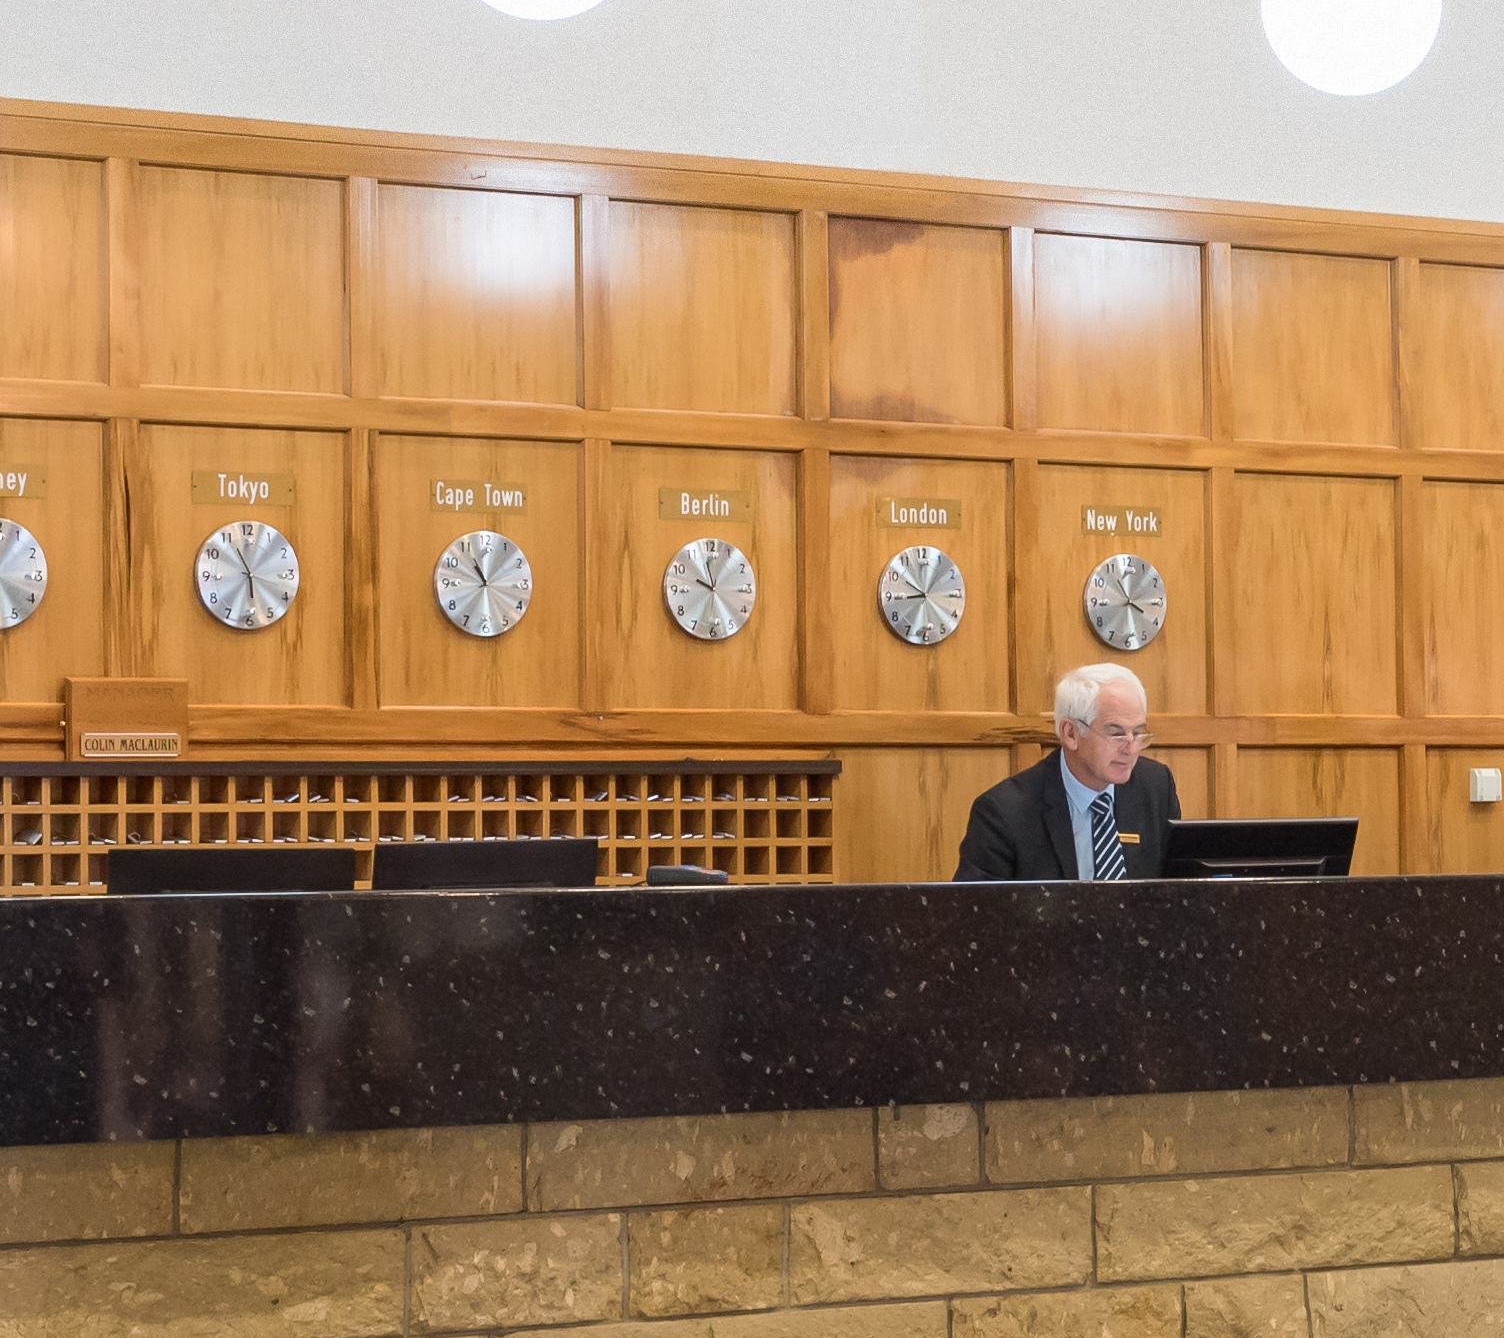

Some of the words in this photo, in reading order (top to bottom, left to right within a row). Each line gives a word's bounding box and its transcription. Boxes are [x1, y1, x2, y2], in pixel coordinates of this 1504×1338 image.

[218, 474, 269, 504] Tokyo
[436, 481, 474, 510] Cape
[484, 484, 523, 506] Town
[681, 493, 729, 516] Berlin
[891, 502, 947, 524] London
[1087, 509, 1117, 531] New
[1126, 511, 1157, 532] York
[242, 525, 253, 535] 12
[222, 533, 231, 543] 11
[480, 535, 491, 545] 12
[461, 542, 470, 552] 11
[706, 542, 715, 552] 12
[30, 548, 36, 559] 2
[207, 549, 219, 559] 10
[281, 548, 287, 559] 2
[687, 549, 696, 559] 11
[917, 549, 926, 558] 12
[447, 557, 458, 567] 10
[517, 558, 522, 569] 2
[901, 556, 909, 566] 11
[1123, 557, 1131, 566] 12
[674, 564, 685, 574] 10
[740, 564, 745, 573] 2
[1106, 564, 1115, 573] 11
[202, 571, 210, 581] 9
[888, 571, 898, 581] 10
[951, 569, 955, 579] 2
[442, 578, 449, 589] 9
[1094, 578, 1104, 588] 10
[1153, 578, 1157, 588] 2
[671, 585, 677, 595] 9
[27, 593, 35, 604] 4
[210, 593, 217, 603] 8
[282, 592, 288, 602] 4
[886, 592, 892, 602] 9
[449, 600, 456, 610] 8
[516, 601, 523, 610] 4
[1091, 598, 1097, 607] 9
[11, 608, 18, 619] 5
[225, 608, 231, 619] 7
[267, 608, 273, 618] 5
[678, 605, 684, 616] 8
[741, 605, 747, 613] 4
[951, 610, 957, 618] 4
[246, 615, 254, 626] 6
[463, 615, 470, 626] 7
[502, 616, 508, 626] 5
[892, 611, 898, 622] 8
[1153, 617, 1158, 626] 4
[691, 620, 697, 630] 7
[728, 620, 734, 629] 5
[1097, 617, 1103, 627] 8
[482, 622, 489, 633] 6
[710, 627, 716, 638] 6
[905, 625, 911, 636] 7
[940, 624, 946, 634] 5
[923, 632, 929, 642] 6
[1109, 631, 1114, 641] 7
[1142, 631, 1147, 641] 5
[1125, 636, 1131, 647] 6
[85, 738, 115, 751] COLIN
[120, 738, 178, 751] MACLAURIN
